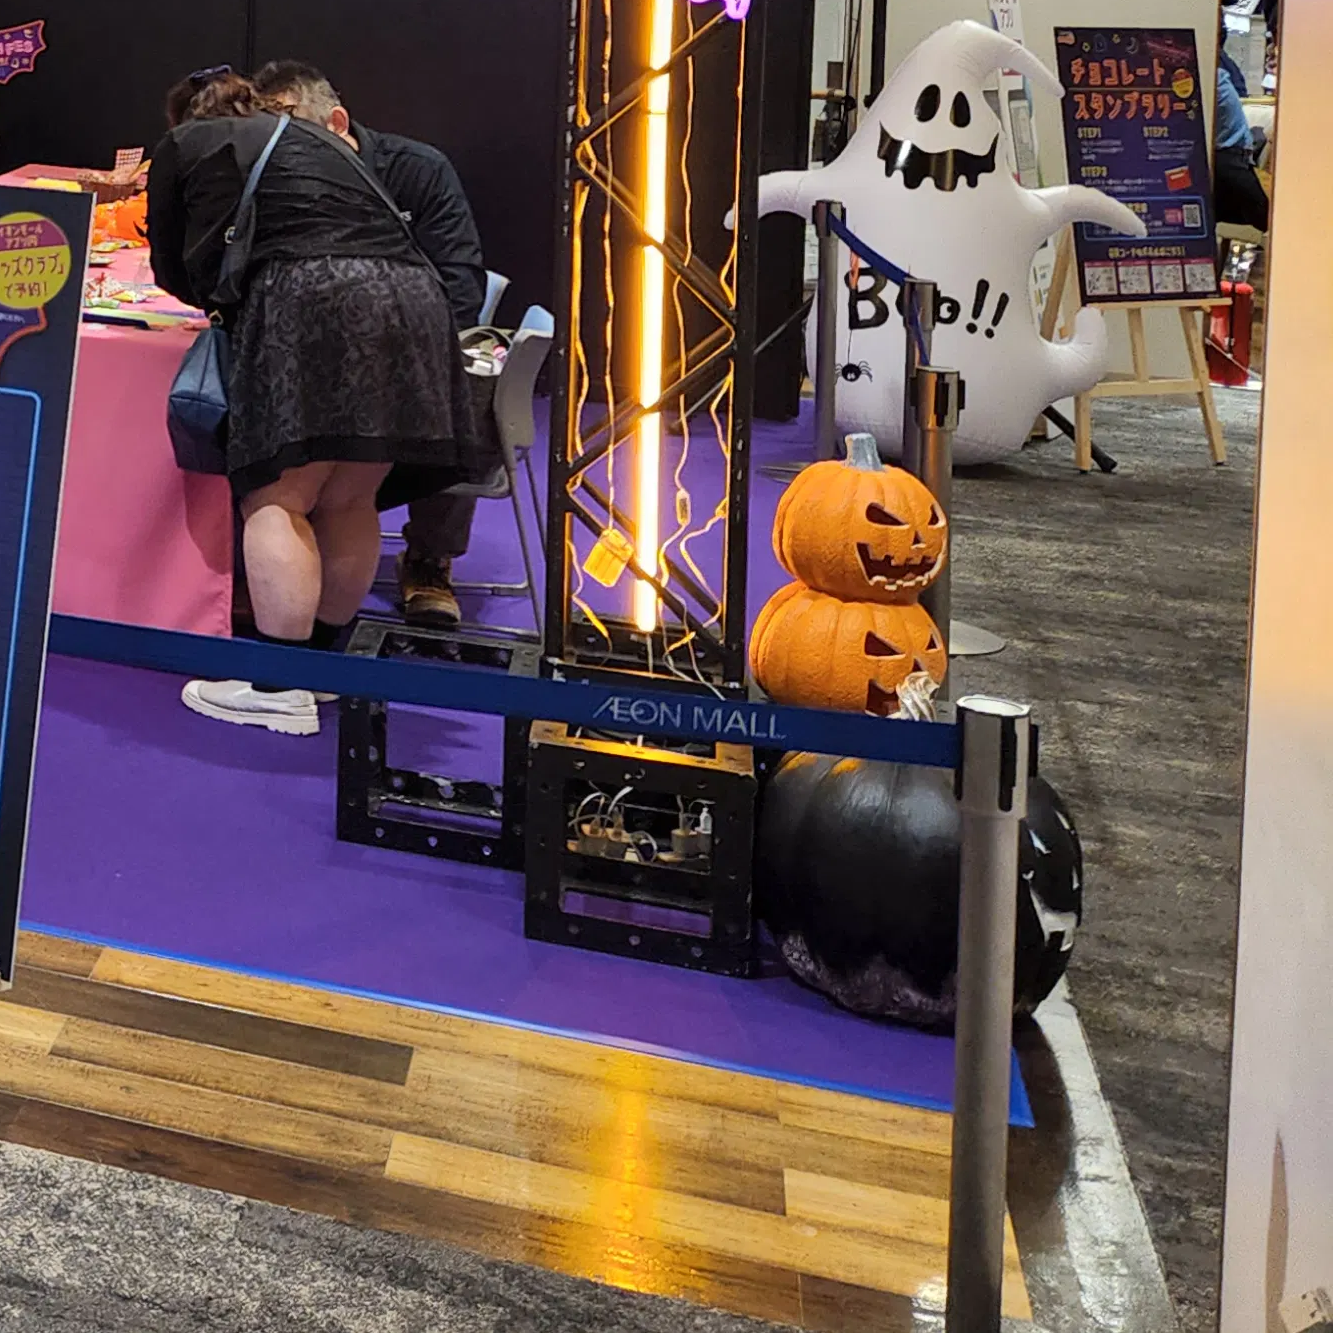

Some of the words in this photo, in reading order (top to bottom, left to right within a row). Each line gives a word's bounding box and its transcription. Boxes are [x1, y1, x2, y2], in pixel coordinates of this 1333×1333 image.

[1070, 57, 1166, 86] チョコレート
[1073, 91, 1186, 120] スタンプラリー
[844, 266, 1010, 340] Bo!!
[692, 707, 788, 741] MALL
